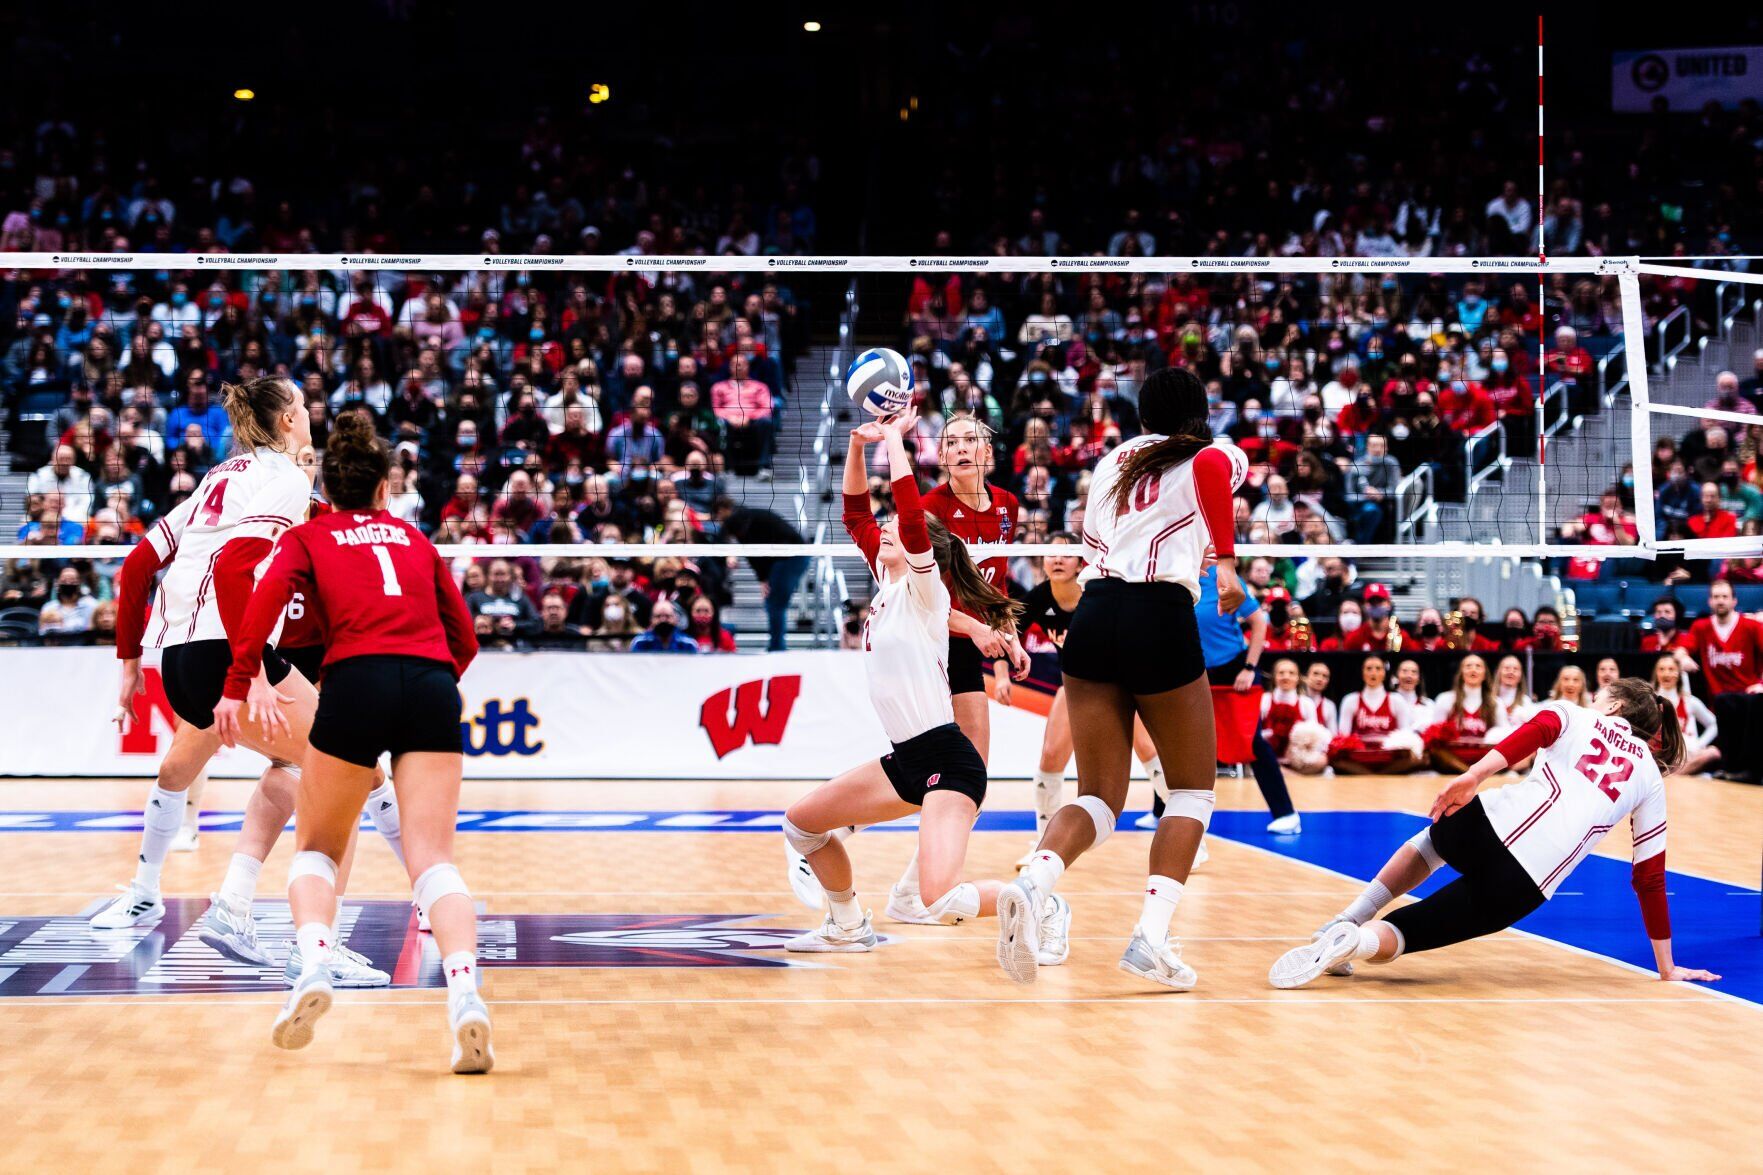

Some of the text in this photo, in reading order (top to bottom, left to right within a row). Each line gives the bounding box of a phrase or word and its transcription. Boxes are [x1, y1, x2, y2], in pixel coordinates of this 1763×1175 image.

[60, 255, 133, 263] VOLLEYBALL CHAMPIONSHIP
[205, 256, 278, 264] VOLLEYBALL CHAMPIONSHIP
[349, 256, 421, 264] VOLLEYBALL CHAMPIONSHIP
[492, 257, 564, 265] VOLLEYBALL CHAMPIONSHIP
[634, 257, 707, 265] VOLLEYBALL CHAMPIONSHIP
[776, 258, 848, 266] VOLLEYBALL CHAMPIONSHIP
[917, 258, 989, 266] VOLLEYBALL CHAMPIONSHIP
[1058, 259, 1130, 267] VOLLEYBALL CHAMPIONSHIP
[1199, 259, 1270, 267] VOLLEYBALL CHAMPIONSHIP
[1339, 259, 1410, 267] VOLLEYBALL CHAMPIONSHIP
[330, 523, 411, 547] BADGERS
[371, 545, 402, 596] 1
[699, 675, 802, 760] W
[1593, 718, 1645, 760] BADGERS
[1574, 737, 1635, 804] 22
